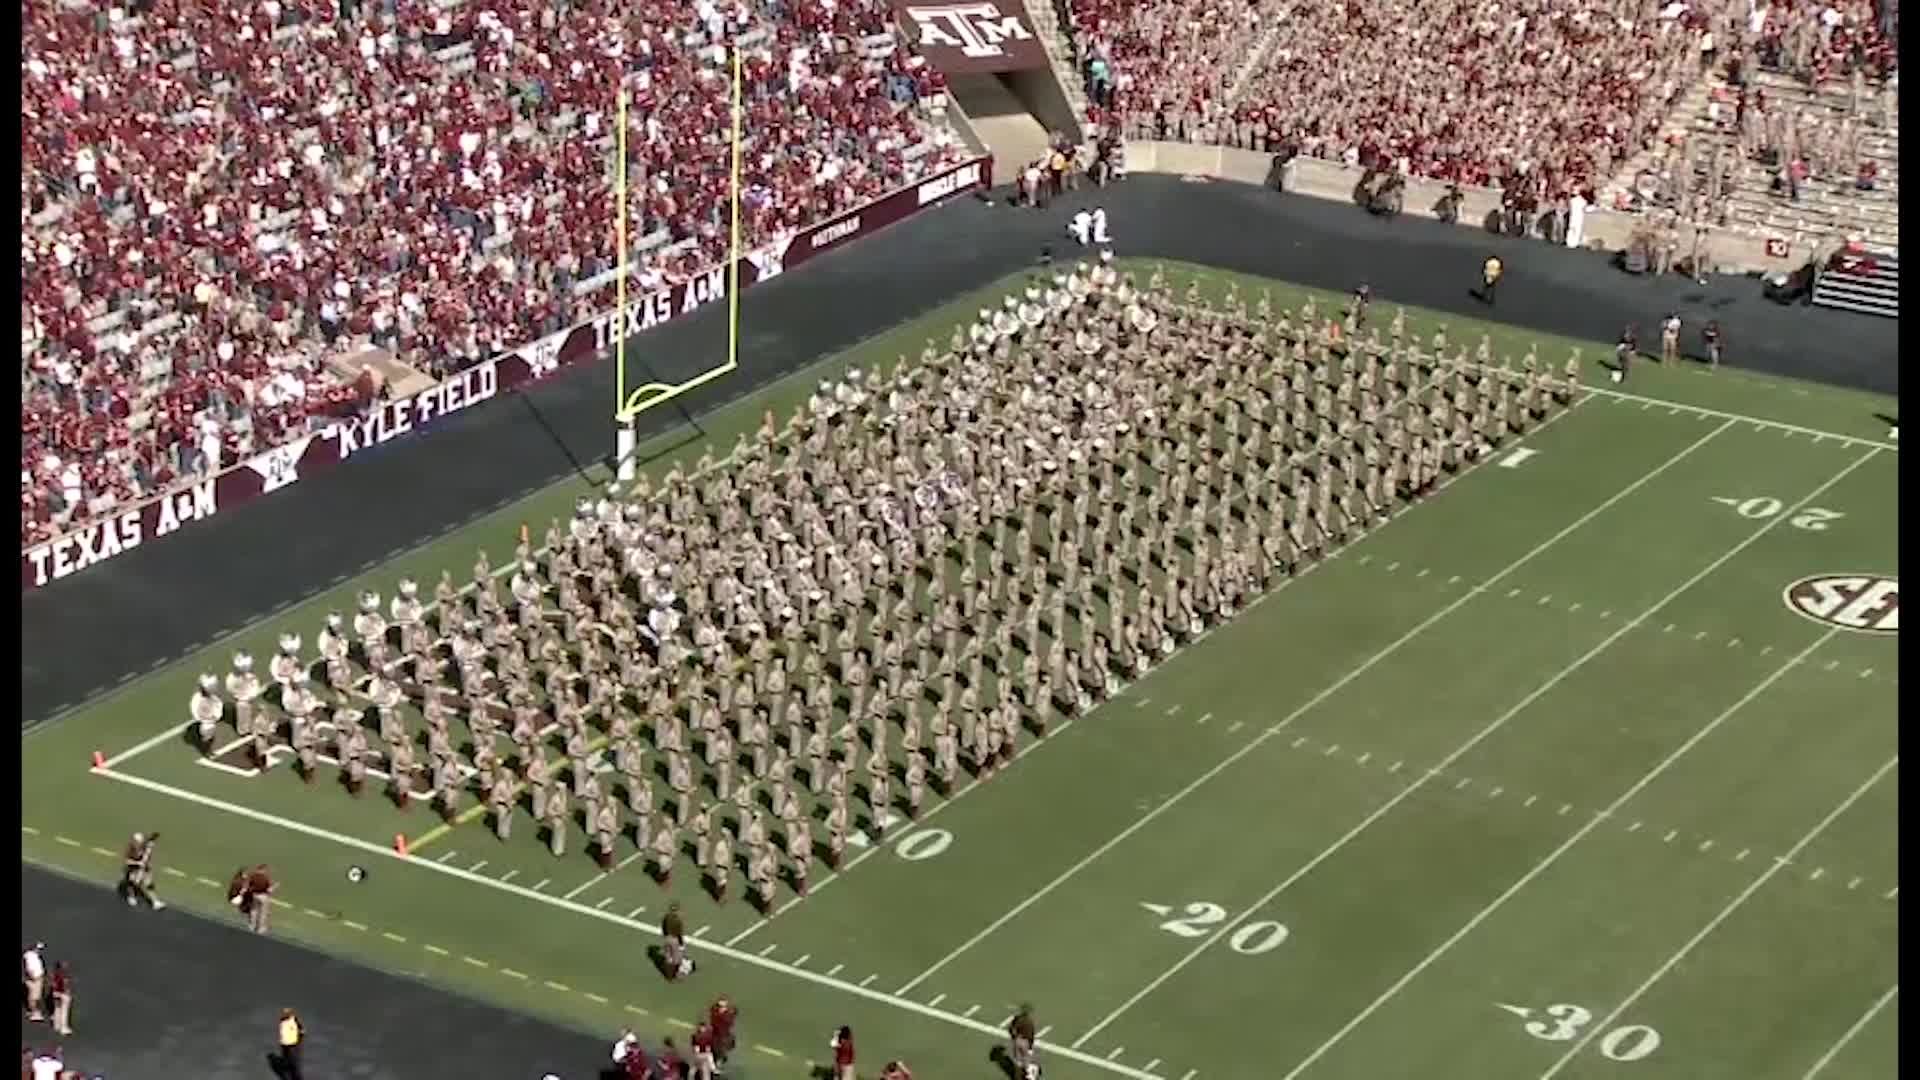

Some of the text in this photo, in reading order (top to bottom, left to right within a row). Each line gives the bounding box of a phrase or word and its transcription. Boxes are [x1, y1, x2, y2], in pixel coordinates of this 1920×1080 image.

[592, 291, 671, 350] TEXAS
[338, 361, 498, 459] KYLE FIELD
[29, 477, 218, 586] TEXAS A&M
[1736, 497, 1847, 531] 20
[1796, 577, 1899, 629] SE
[1159, 901, 1289, 954] 20
[1525, 1003, 1661, 1061] 30
